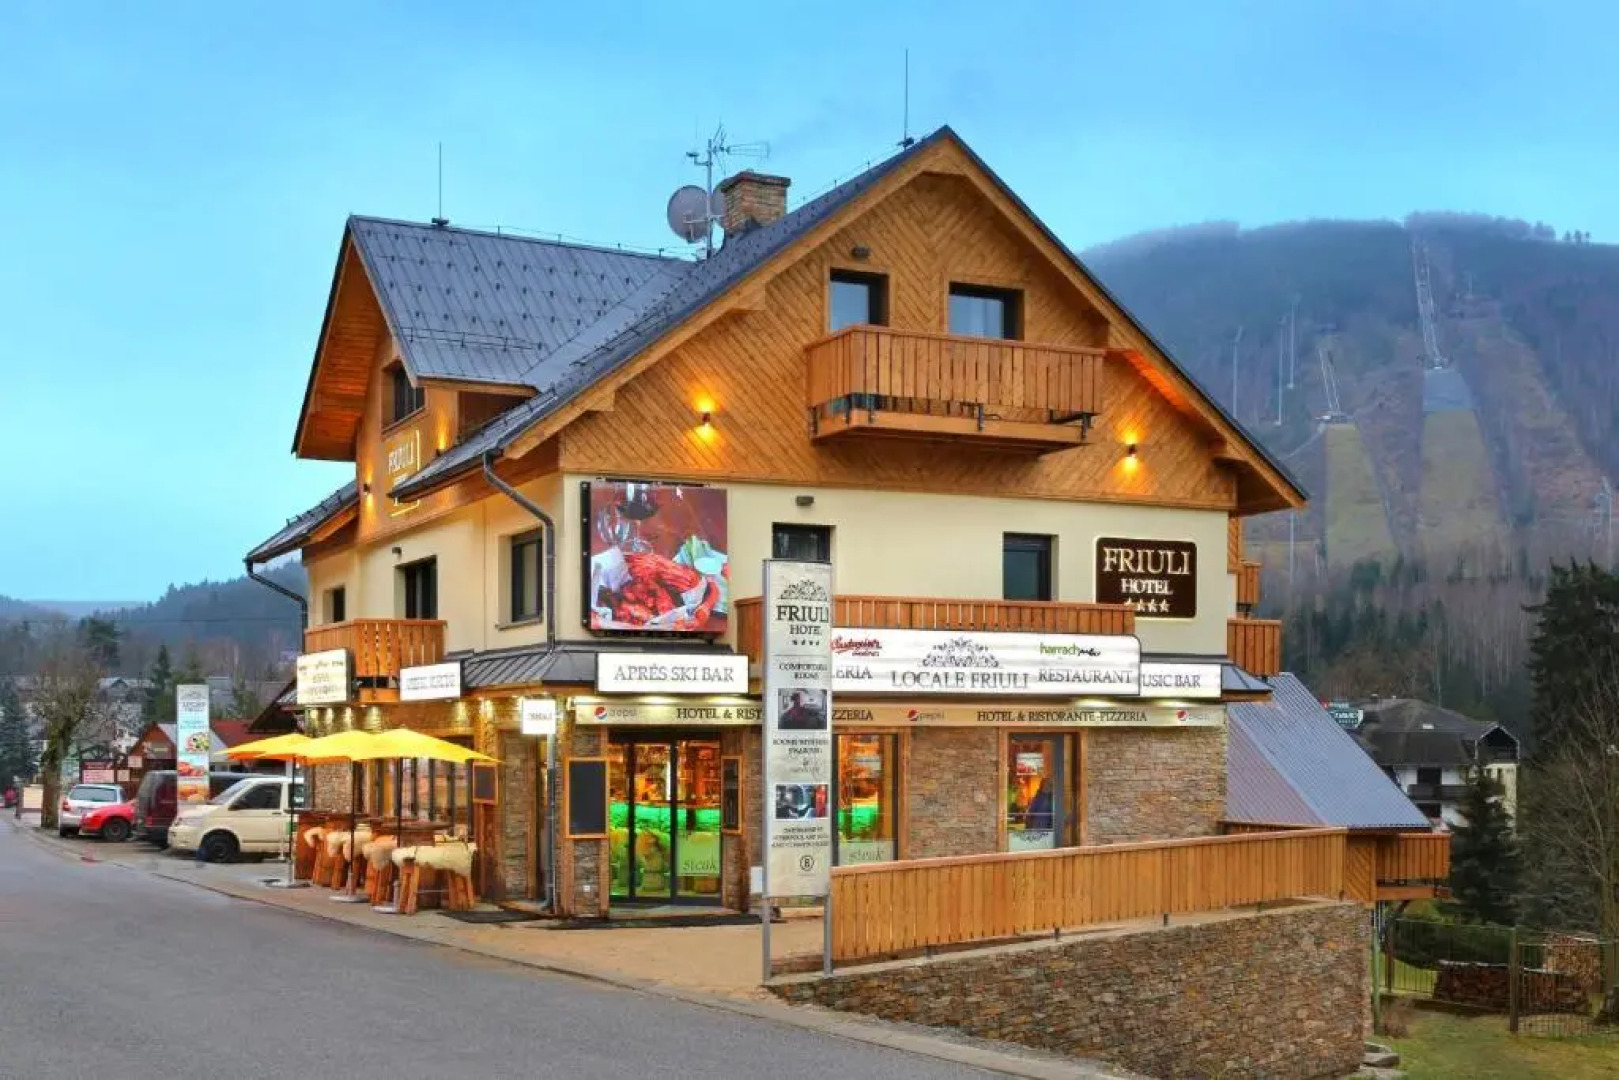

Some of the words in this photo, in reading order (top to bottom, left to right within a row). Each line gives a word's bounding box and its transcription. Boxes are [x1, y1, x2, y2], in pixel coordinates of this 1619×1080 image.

[1103, 546, 1190, 575] FRIULI
[1120, 578, 1174, 595] HOTEL
[671, 666, 698, 681] SKI
[702, 667, 734, 682] BAR
[891, 670, 966, 688] LOCALE
[971, 671, 1028, 689] FRIULI
[1038, 668, 1132, 684] RESTAURANT
[1174, 674, 1201, 688] BAR
[676, 707, 719, 719] HOTEL
[723, 709, 733, 719] &
[977, 711, 1015, 722] HOTEL
[1017, 711, 1026, 722] &
